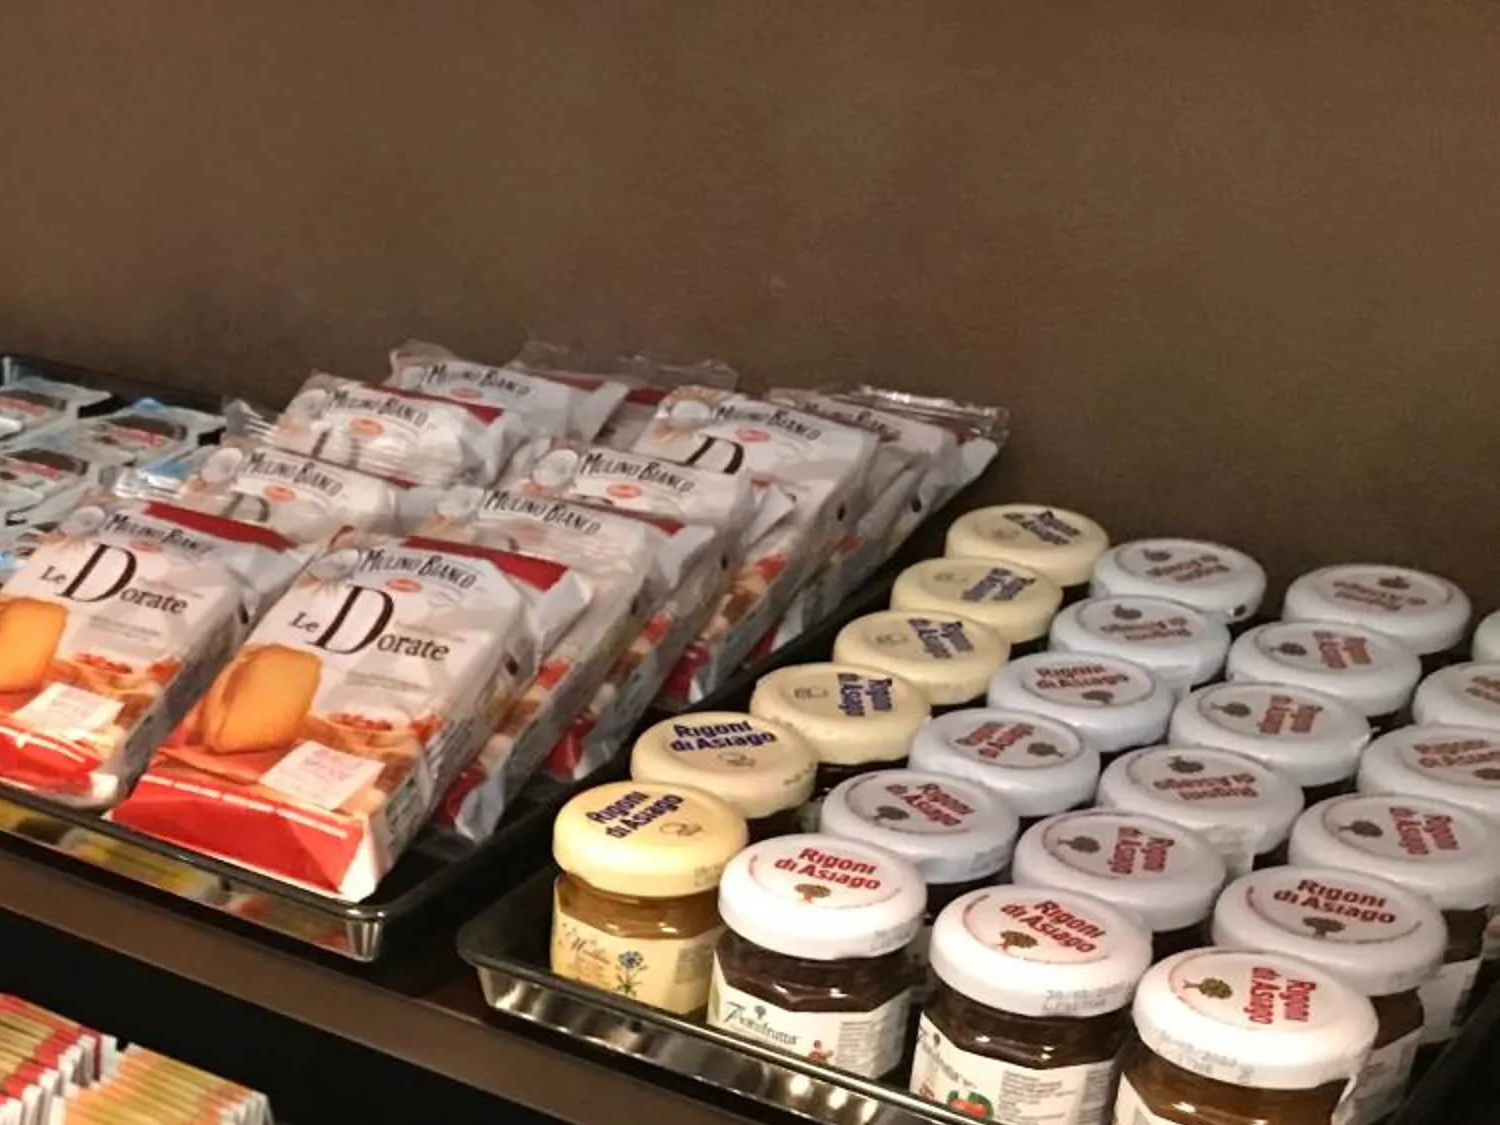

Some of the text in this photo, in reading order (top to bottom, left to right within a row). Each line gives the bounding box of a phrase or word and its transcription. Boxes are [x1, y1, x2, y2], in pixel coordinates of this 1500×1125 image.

[40, 565, 67, 584] Le
[55, 543, 189, 614] Dorate
[288, 612, 320, 632] Le
[306, 584, 450, 661] Dorate
[670, 732, 778, 751] di Asiago
[674, 720, 752, 738] Rigoni
[585, 790, 650, 824] Rigoni
[605, 794, 685, 838] di Asiago
[774, 858, 881, 890] di Asiago
[798, 847, 877, 874] Rigoni
[1273, 890, 1397, 924] di Asiago
[1297, 879, 1387, 907] Rigoni
[1000, 904, 1097, 953] di Asiago
[1033, 900, 1106, 939] Rigoni
